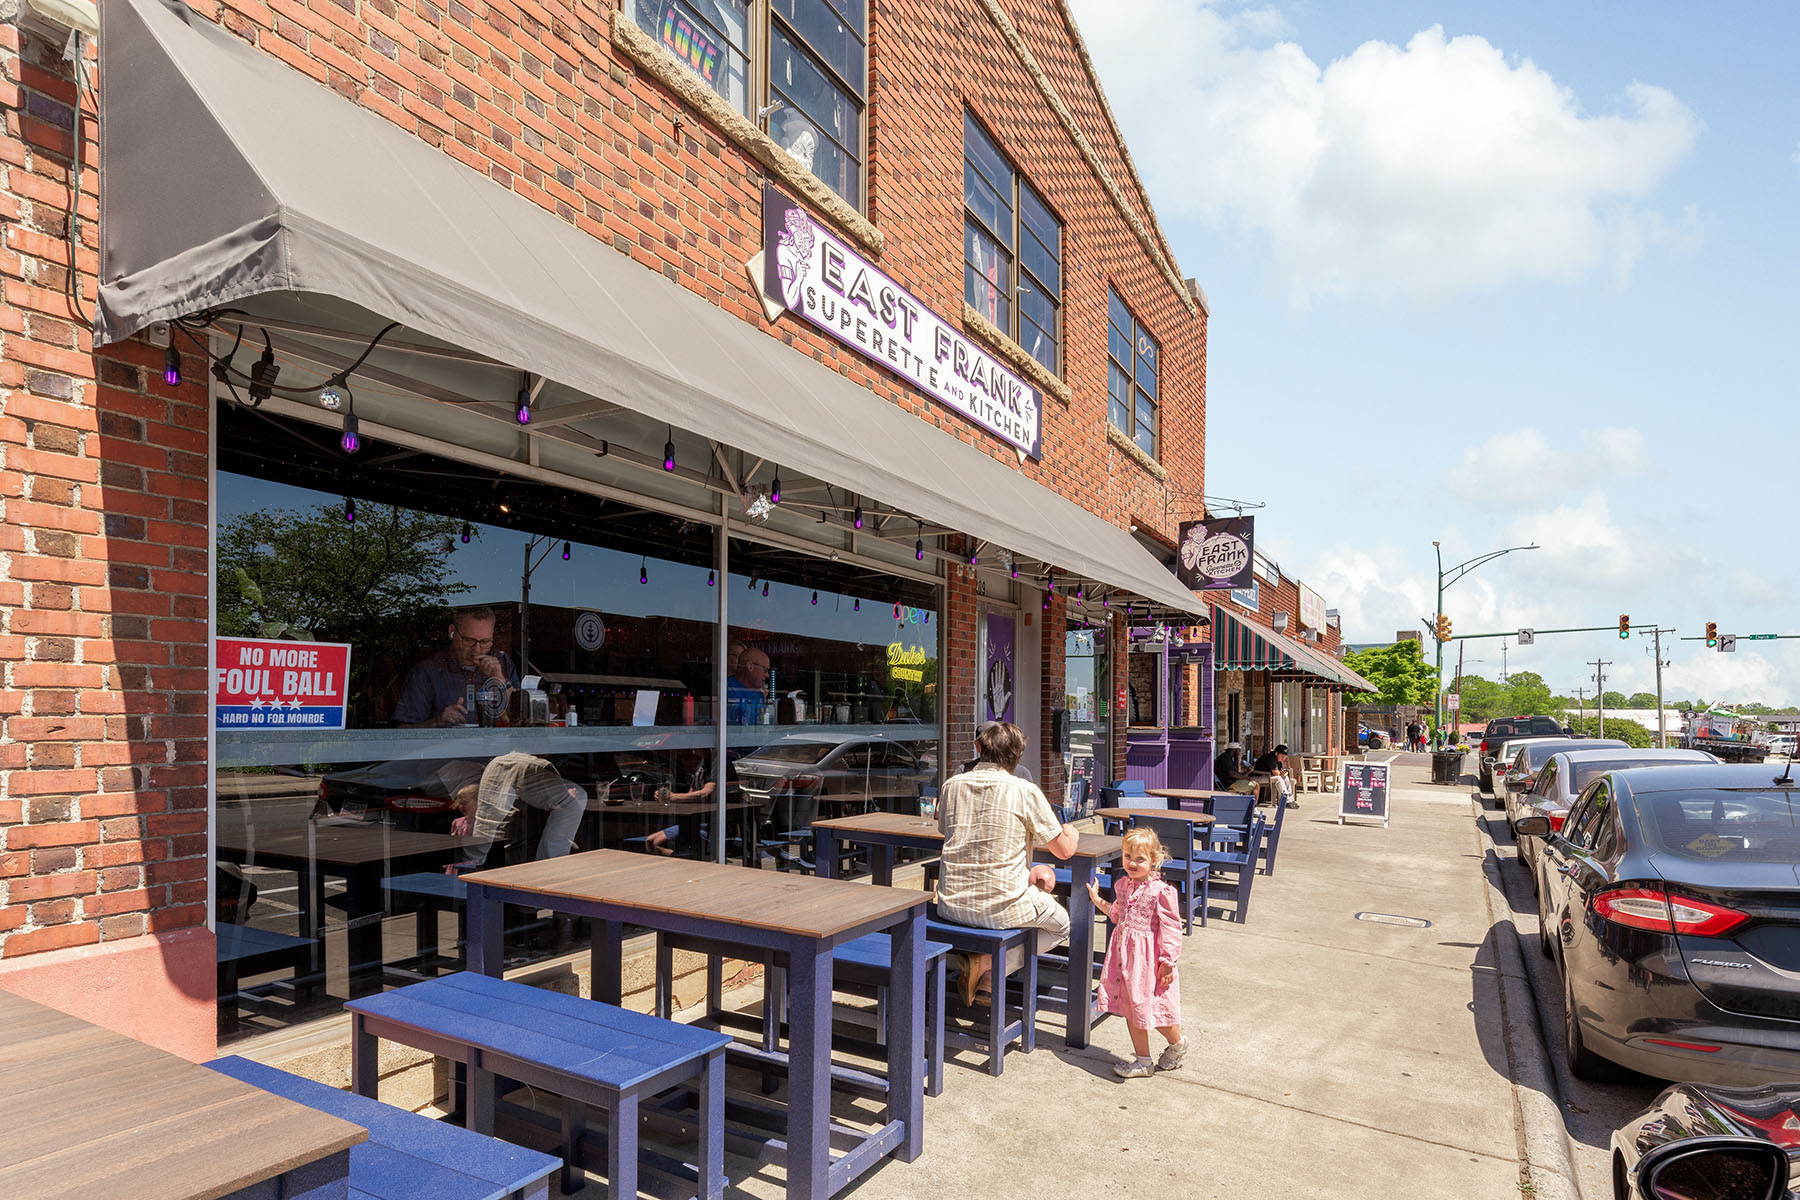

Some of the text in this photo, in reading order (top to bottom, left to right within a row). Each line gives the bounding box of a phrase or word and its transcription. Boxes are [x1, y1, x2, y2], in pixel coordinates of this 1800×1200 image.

[664, 8, 717, 82] LOVE
[821, 241, 1022, 418] EAST FRANK
[806, 286, 1030, 446] SUPERETTE AND KITCHEN
[1199, 549, 1246, 566] FRANK
[1202, 540, 1239, 556] EAST
[1209, 566, 1241, 576] KITCHEN
[239, 647, 318, 668] NO MORE
[887, 642, 926, 666] Duke's
[216, 668, 337, 696] FOUL BALL
[222, 713, 325, 723] HARD NO FOR MONROE
[1691, 958, 1752, 969] FUSION
